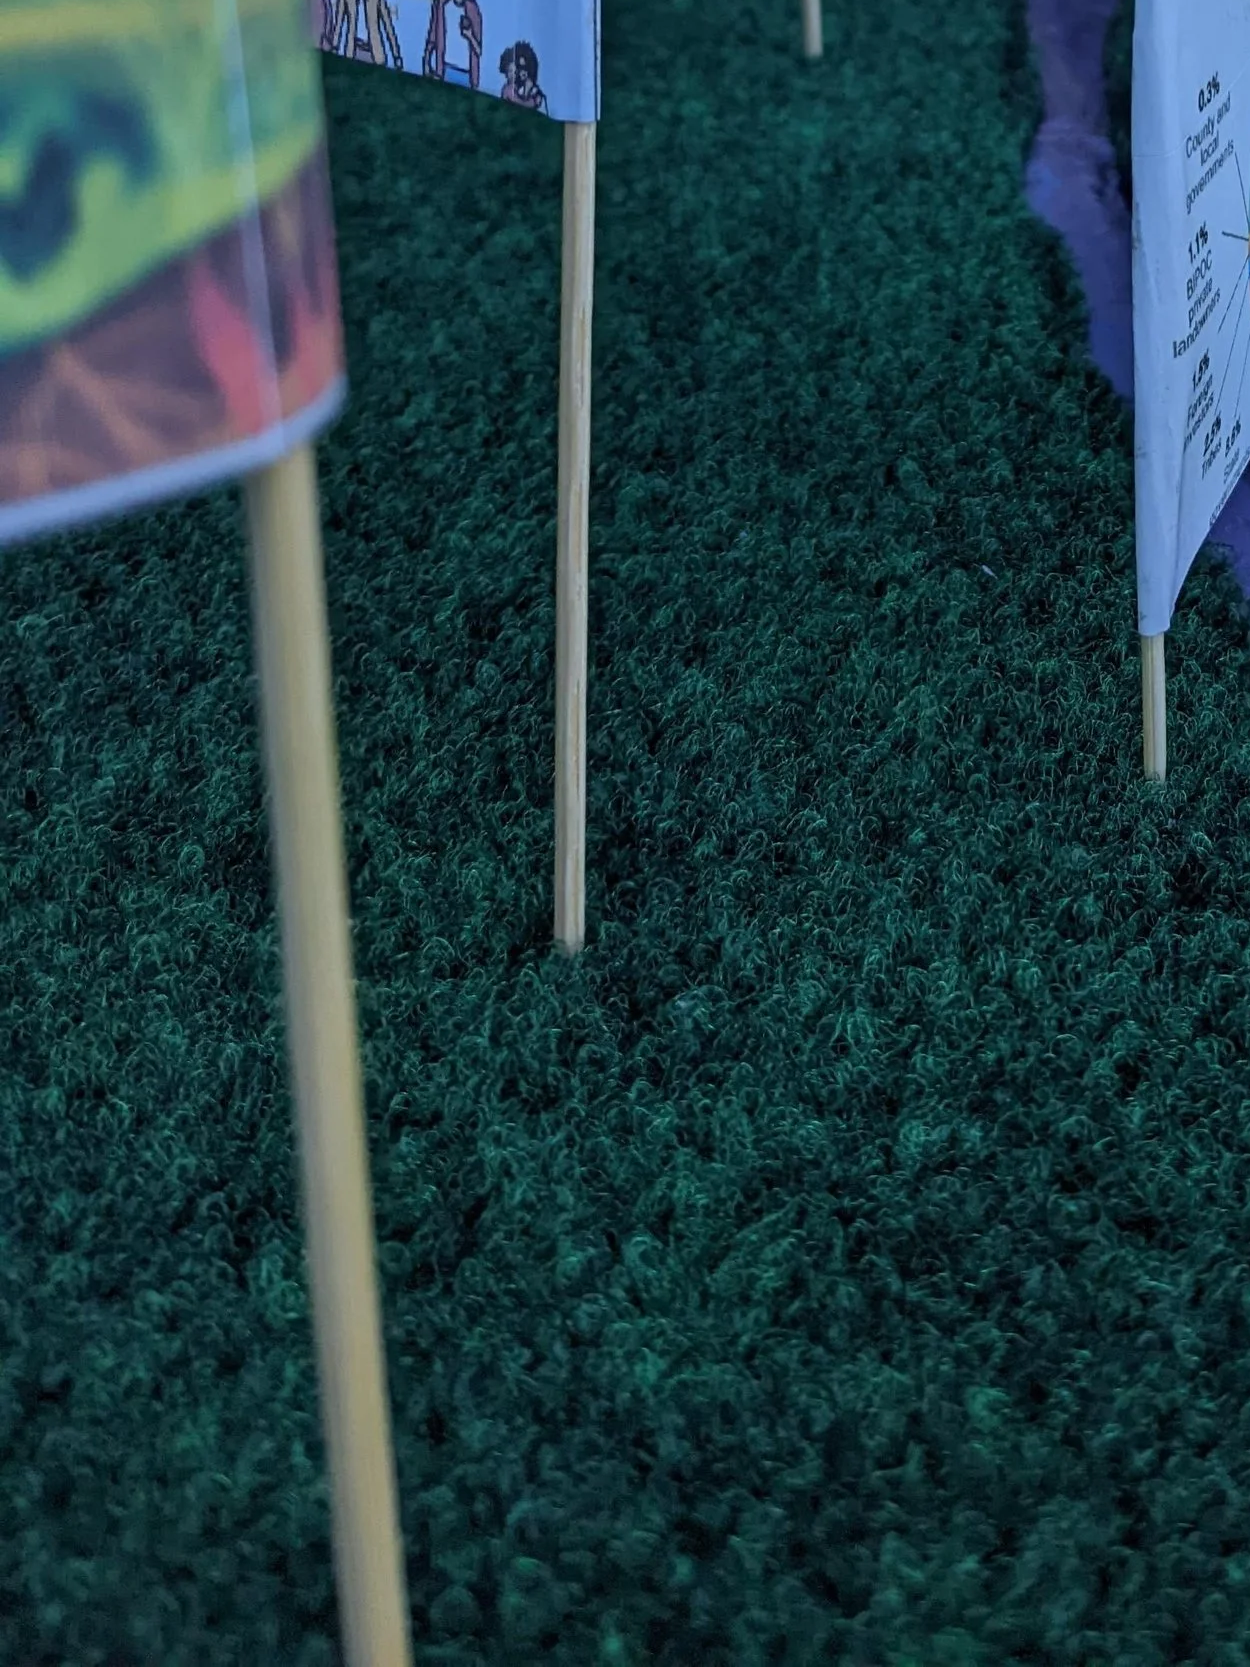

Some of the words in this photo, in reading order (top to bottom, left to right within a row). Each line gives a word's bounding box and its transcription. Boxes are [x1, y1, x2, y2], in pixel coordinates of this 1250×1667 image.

[1198, 72, 1221, 113] 0.3%
[1186, 114, 1215, 160] County
[1216, 90, 1231, 123] and
[1201, 130, 1220, 167] local
[1187, 139, 1234, 216] governments
[1188, 220, 1209, 265] 1.1%
[1186, 248, 1213, 302] BIPOC
[1173, 287, 1221, 359] landowners
[1187, 276, 1213, 328] private
